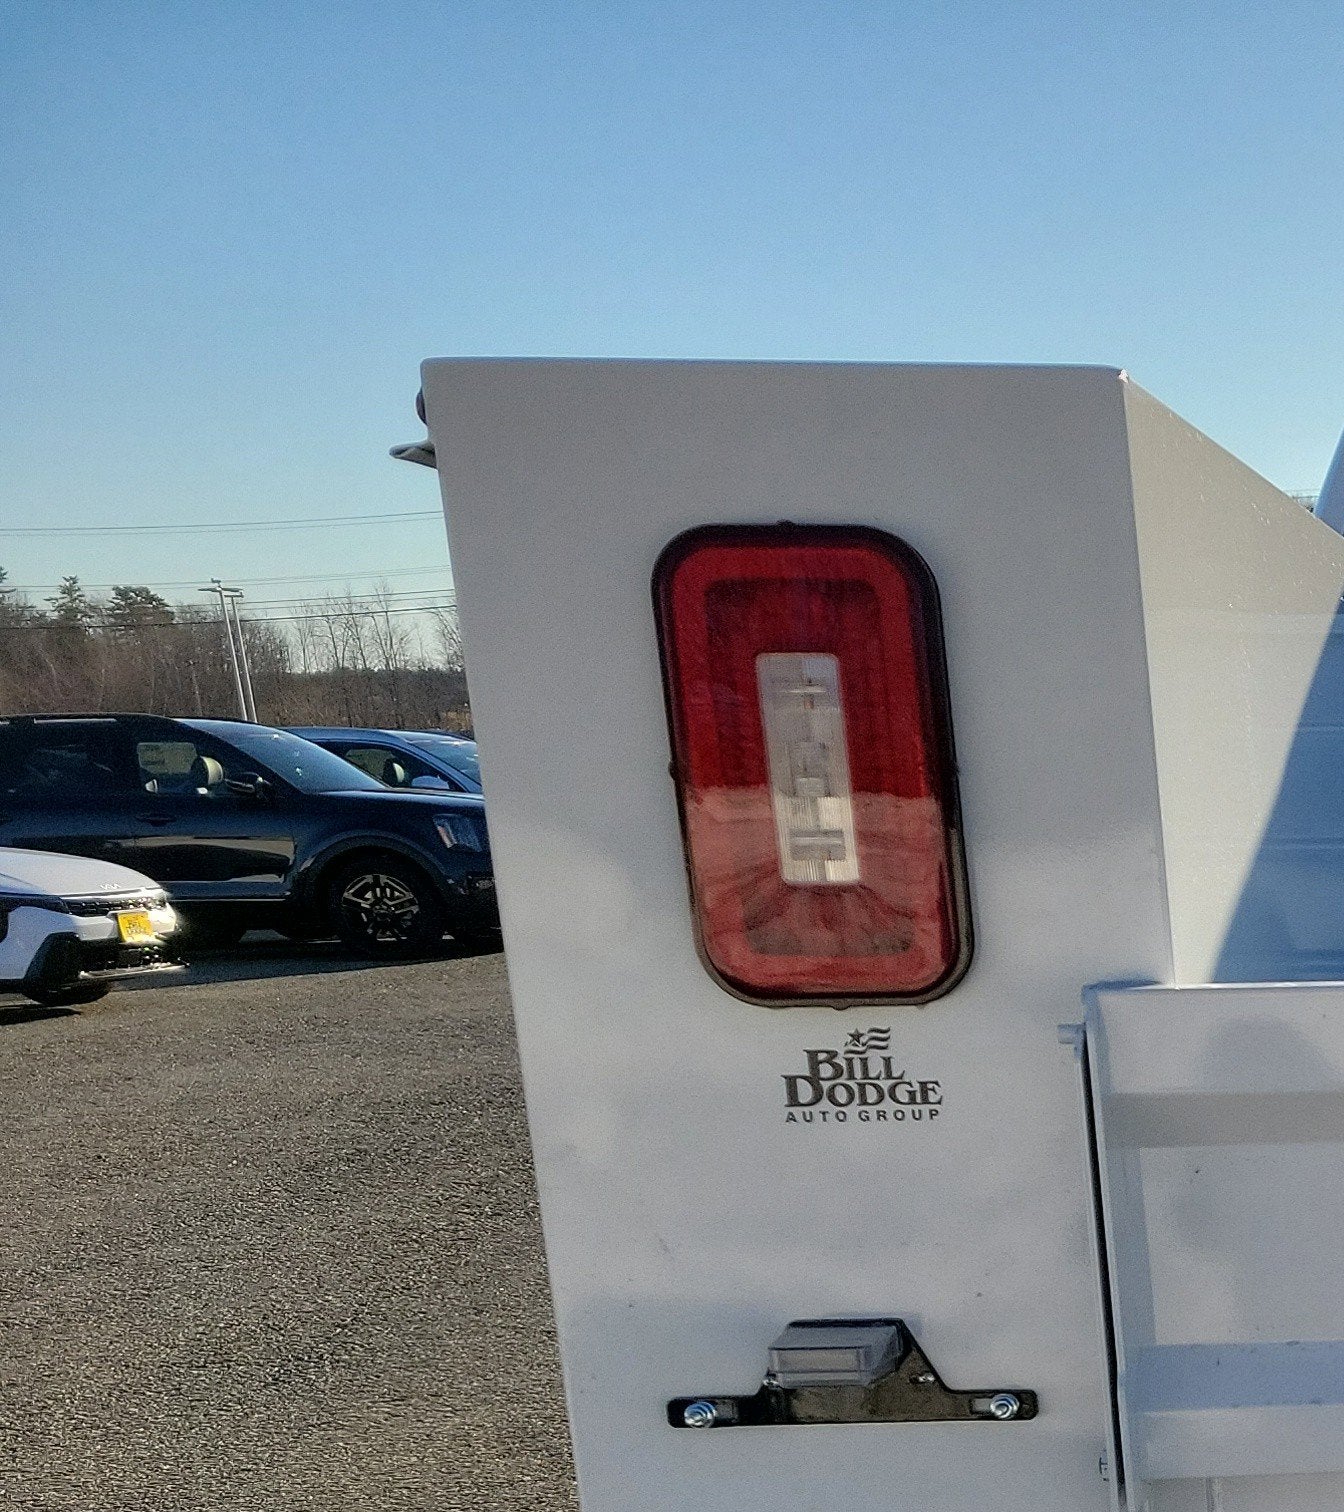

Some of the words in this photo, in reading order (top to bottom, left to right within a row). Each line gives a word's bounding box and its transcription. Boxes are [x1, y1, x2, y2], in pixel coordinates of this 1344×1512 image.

[803, 1049, 905, 1081] BILL
[780, 1074, 943, 1108] DODGE
[785, 1111, 847, 1123] AUTO
[857, 1109, 940, 1122] GROUP
